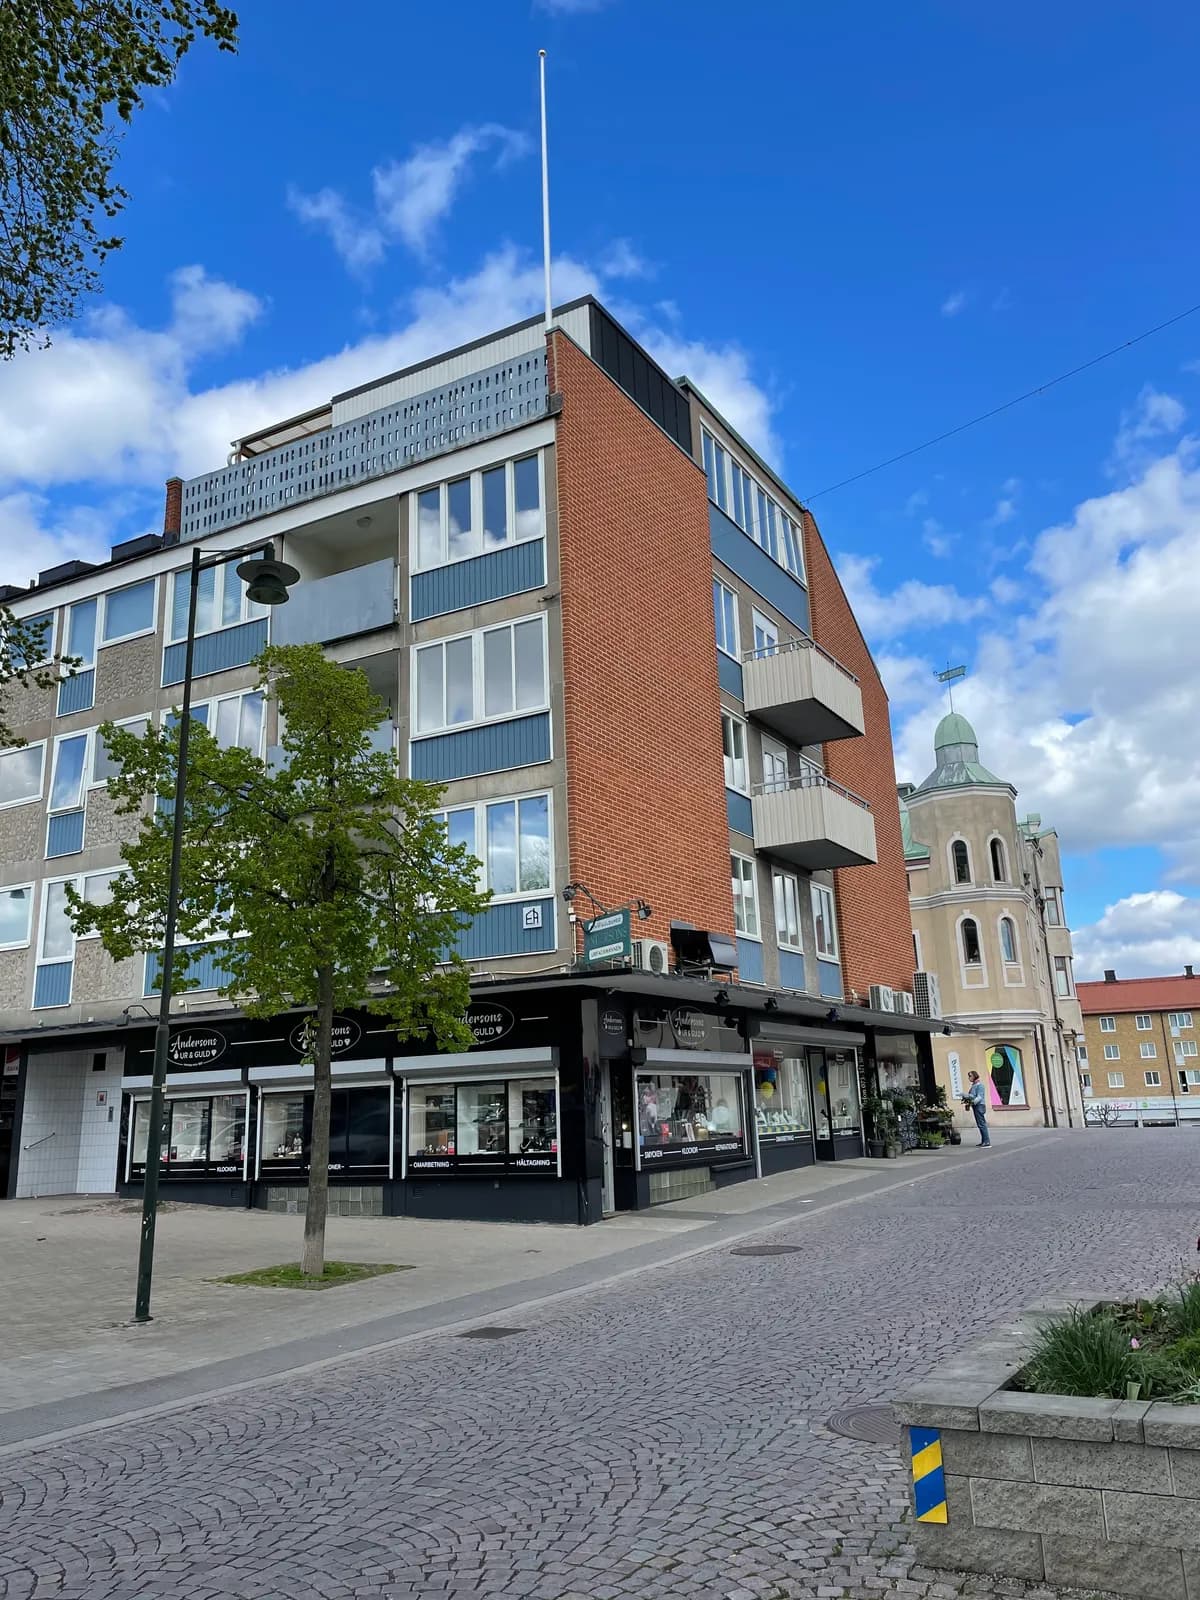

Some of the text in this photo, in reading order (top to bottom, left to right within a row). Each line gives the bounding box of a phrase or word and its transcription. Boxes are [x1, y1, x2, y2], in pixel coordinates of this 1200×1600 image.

[456, 1011, 503, 1024] ndersons
[474, 1027, 495, 1036] GULD
[170, 1035, 217, 1052] Andersons
[194, 1050, 210, 1058] GULD
